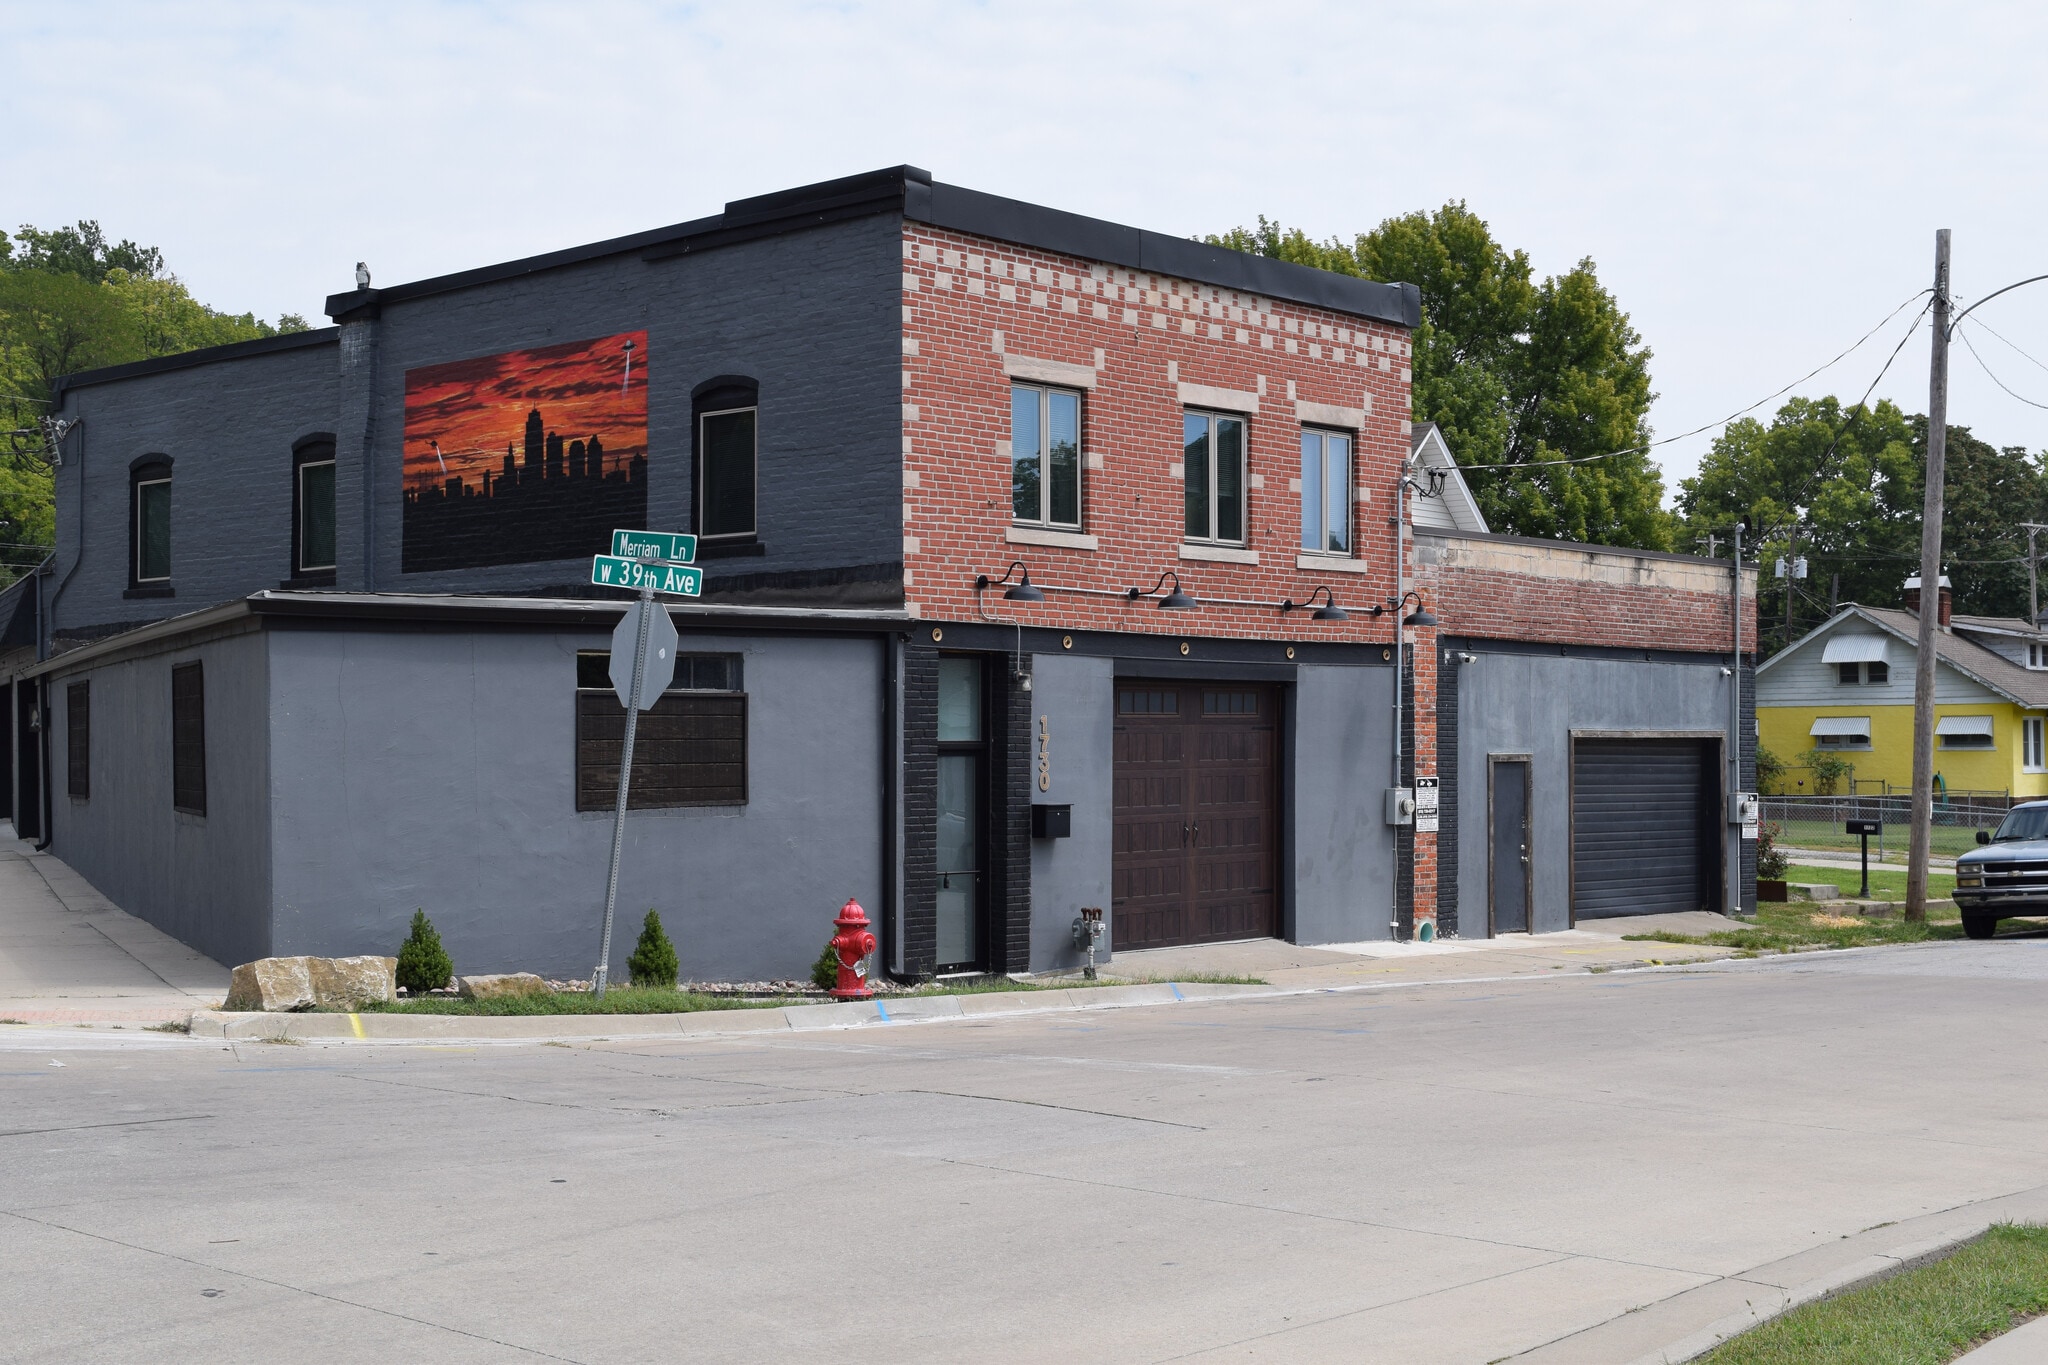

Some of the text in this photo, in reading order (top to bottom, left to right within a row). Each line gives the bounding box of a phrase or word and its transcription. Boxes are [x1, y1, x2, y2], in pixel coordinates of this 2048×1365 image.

[619, 533, 686, 560] Merriam Ln
[601, 561, 695, 593] W 39th Ave
[1039, 715, 1050, 791] 1730
